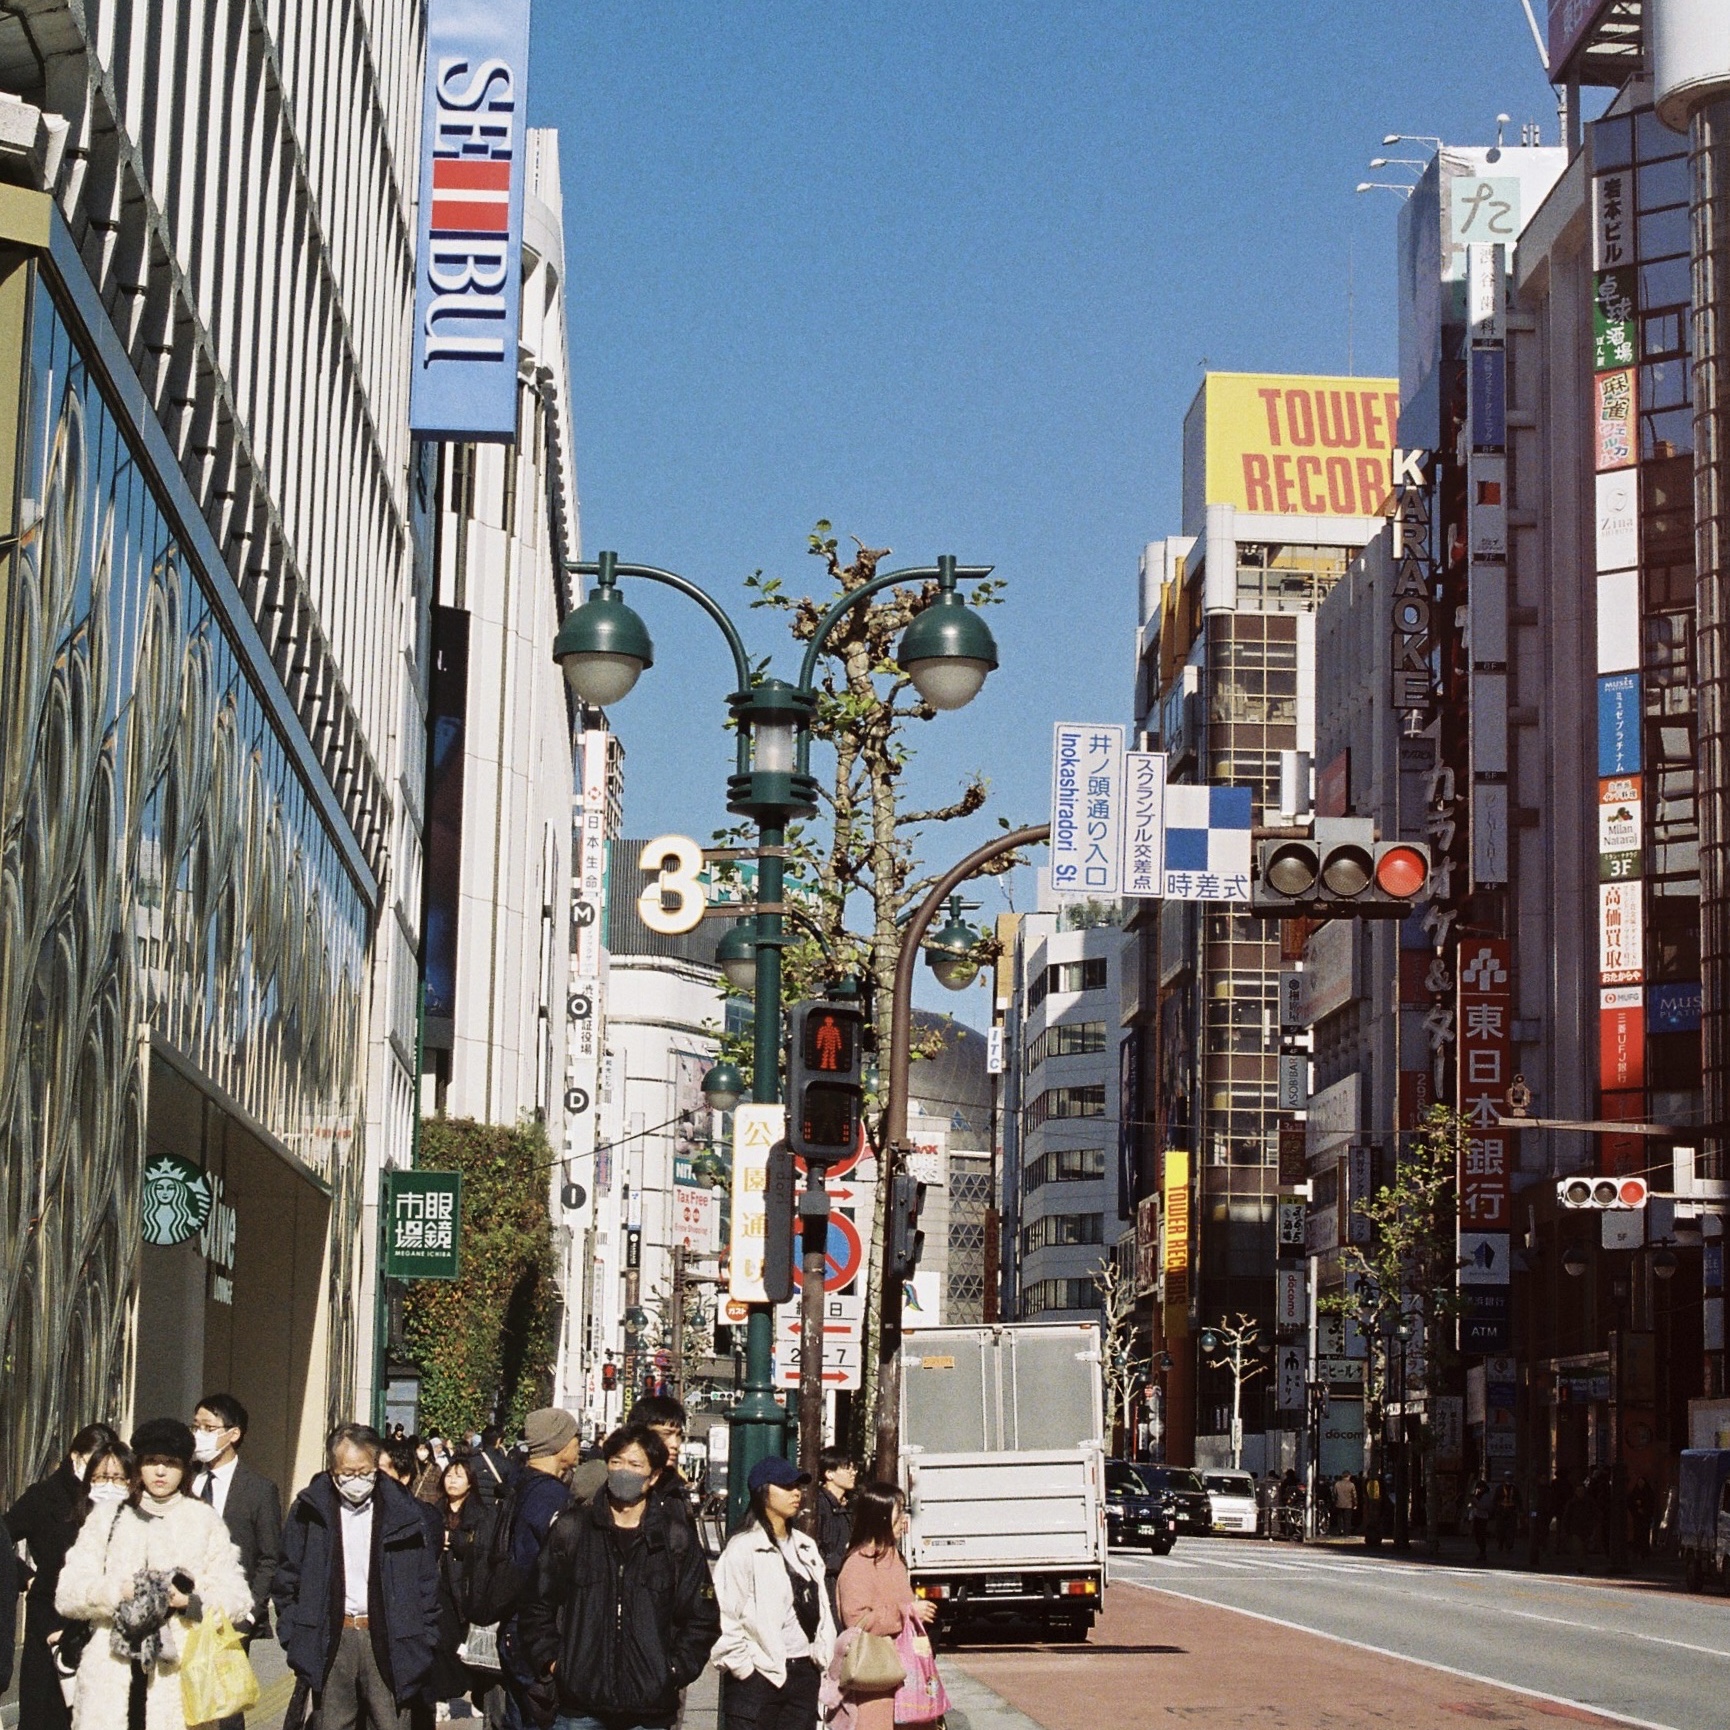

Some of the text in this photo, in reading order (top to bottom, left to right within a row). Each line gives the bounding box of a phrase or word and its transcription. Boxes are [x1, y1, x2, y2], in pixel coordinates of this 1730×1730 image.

[423, 57, 516, 369] SEIBU
[1603, 177, 1622, 263] 岩本ビル
[1598, 275, 1633, 363] 卓球酒場
[1602, 372, 1630, 421] 麻雀
[1241, 452, 1393, 516] RECOR
[1391, 448, 1431, 710] KARAOKE
[1615, 692, 1624, 773] ミュゼプラチナム
[1055, 733, 1081, 887] Inokashiradori St.
[1085, 733, 1113, 887] 井ノ頭通り入口
[1133, 758, 1155, 890] スクランブル交差点
[1604, 833, 1638, 846] Nataraj
[1609, 824, 1634, 836] Milan
[586, 815, 599, 888] 日本生命
[637, 834, 707, 935] 3
[1610, 859, 1633, 877] 3F
[1167, 873, 1248, 899] 時差式
[1605, 886, 1622, 969] 高価買取
[1602, 970, 1641, 983] おたからや
[1617, 992, 1639, 1002] MUFG
[1617, 1012, 1627, 1083] 三菱UFJ銀行
[1464, 1002, 1504, 1220] 東日本銀行
[741, 1120, 772, 1284] 公園通り
[1168, 1183, 1188, 1235] TOWER
[394, 1249, 425, 1257] MEGANE
[728, 1308, 747, 1316] ガスト
[1287, 1274, 1297, 1317] docomo
[790, 1347, 846, 1363] 2-7
[1471, 1326, 1498, 1337] ATM
